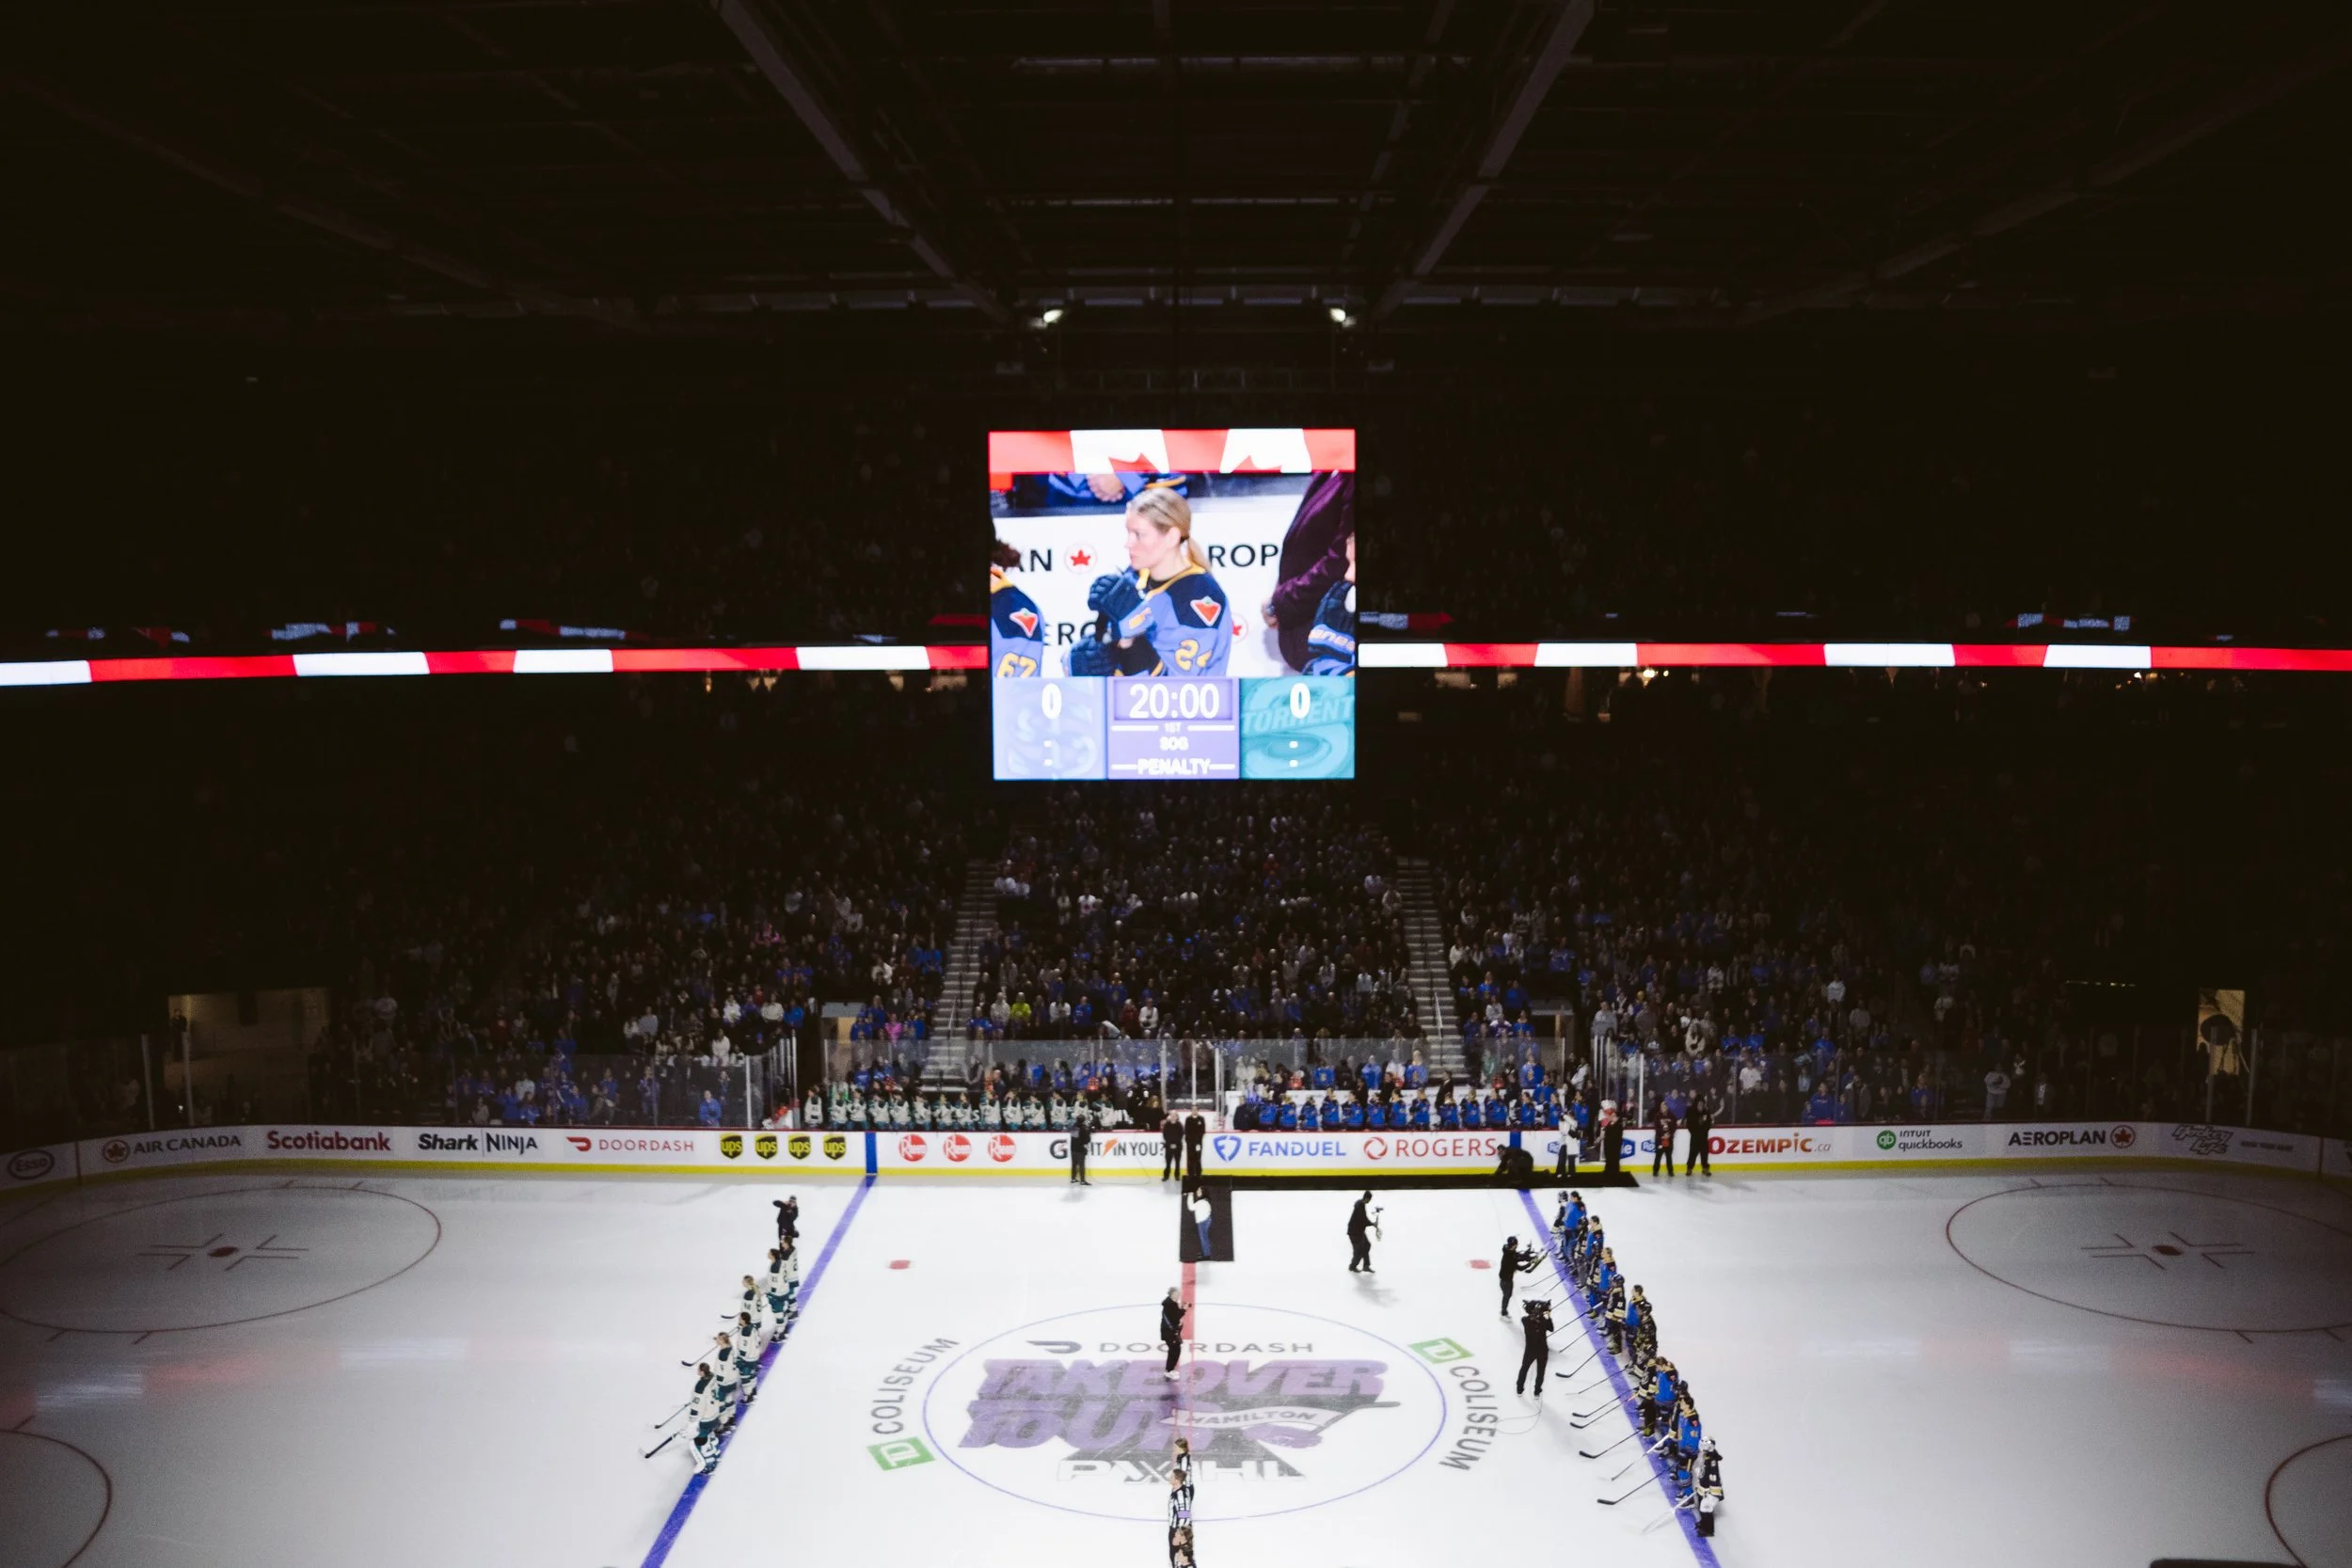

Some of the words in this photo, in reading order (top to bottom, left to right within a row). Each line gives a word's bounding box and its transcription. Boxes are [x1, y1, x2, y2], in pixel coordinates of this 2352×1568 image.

[1041, 683, 1062, 720] 0
[1129, 683, 1220, 719] 20:00
[1290, 683, 1311, 719] 0
[1137, 758, 1212, 776] PENALTY
[134, 1142, 164, 1154] AIR
[167, 1134, 242, 1151] CANADA
[267, 1131, 391, 1151] Scotiabank
[418, 1132, 478, 1151] Shark
[485, 1132, 538, 1155] NINJA
[599, 1139, 694, 1151] DOORDASH
[1396, 1138, 1497, 1158] ROGERS
[1899, 1137, 1963, 1152] quickbooks
[2009, 1131, 2106, 1147] AEROPLAN
[721, 1141, 742, 1157] ups
[755, 1141, 777, 1157] ups
[789, 1141, 811, 1157] ups
[823, 1141, 847, 1158] ups
[1130, 1142, 1166, 1157] YOU?
[1248, 1141, 1346, 1157] FANDUEL
[868, 1337, 961, 1435] COLISEUM
[977, 1359, 1389, 1396] TAKEOVER
[1185, 1411, 1319, 1425] HAMILTON
[1438, 1365, 1500, 1472] COLISEUM
